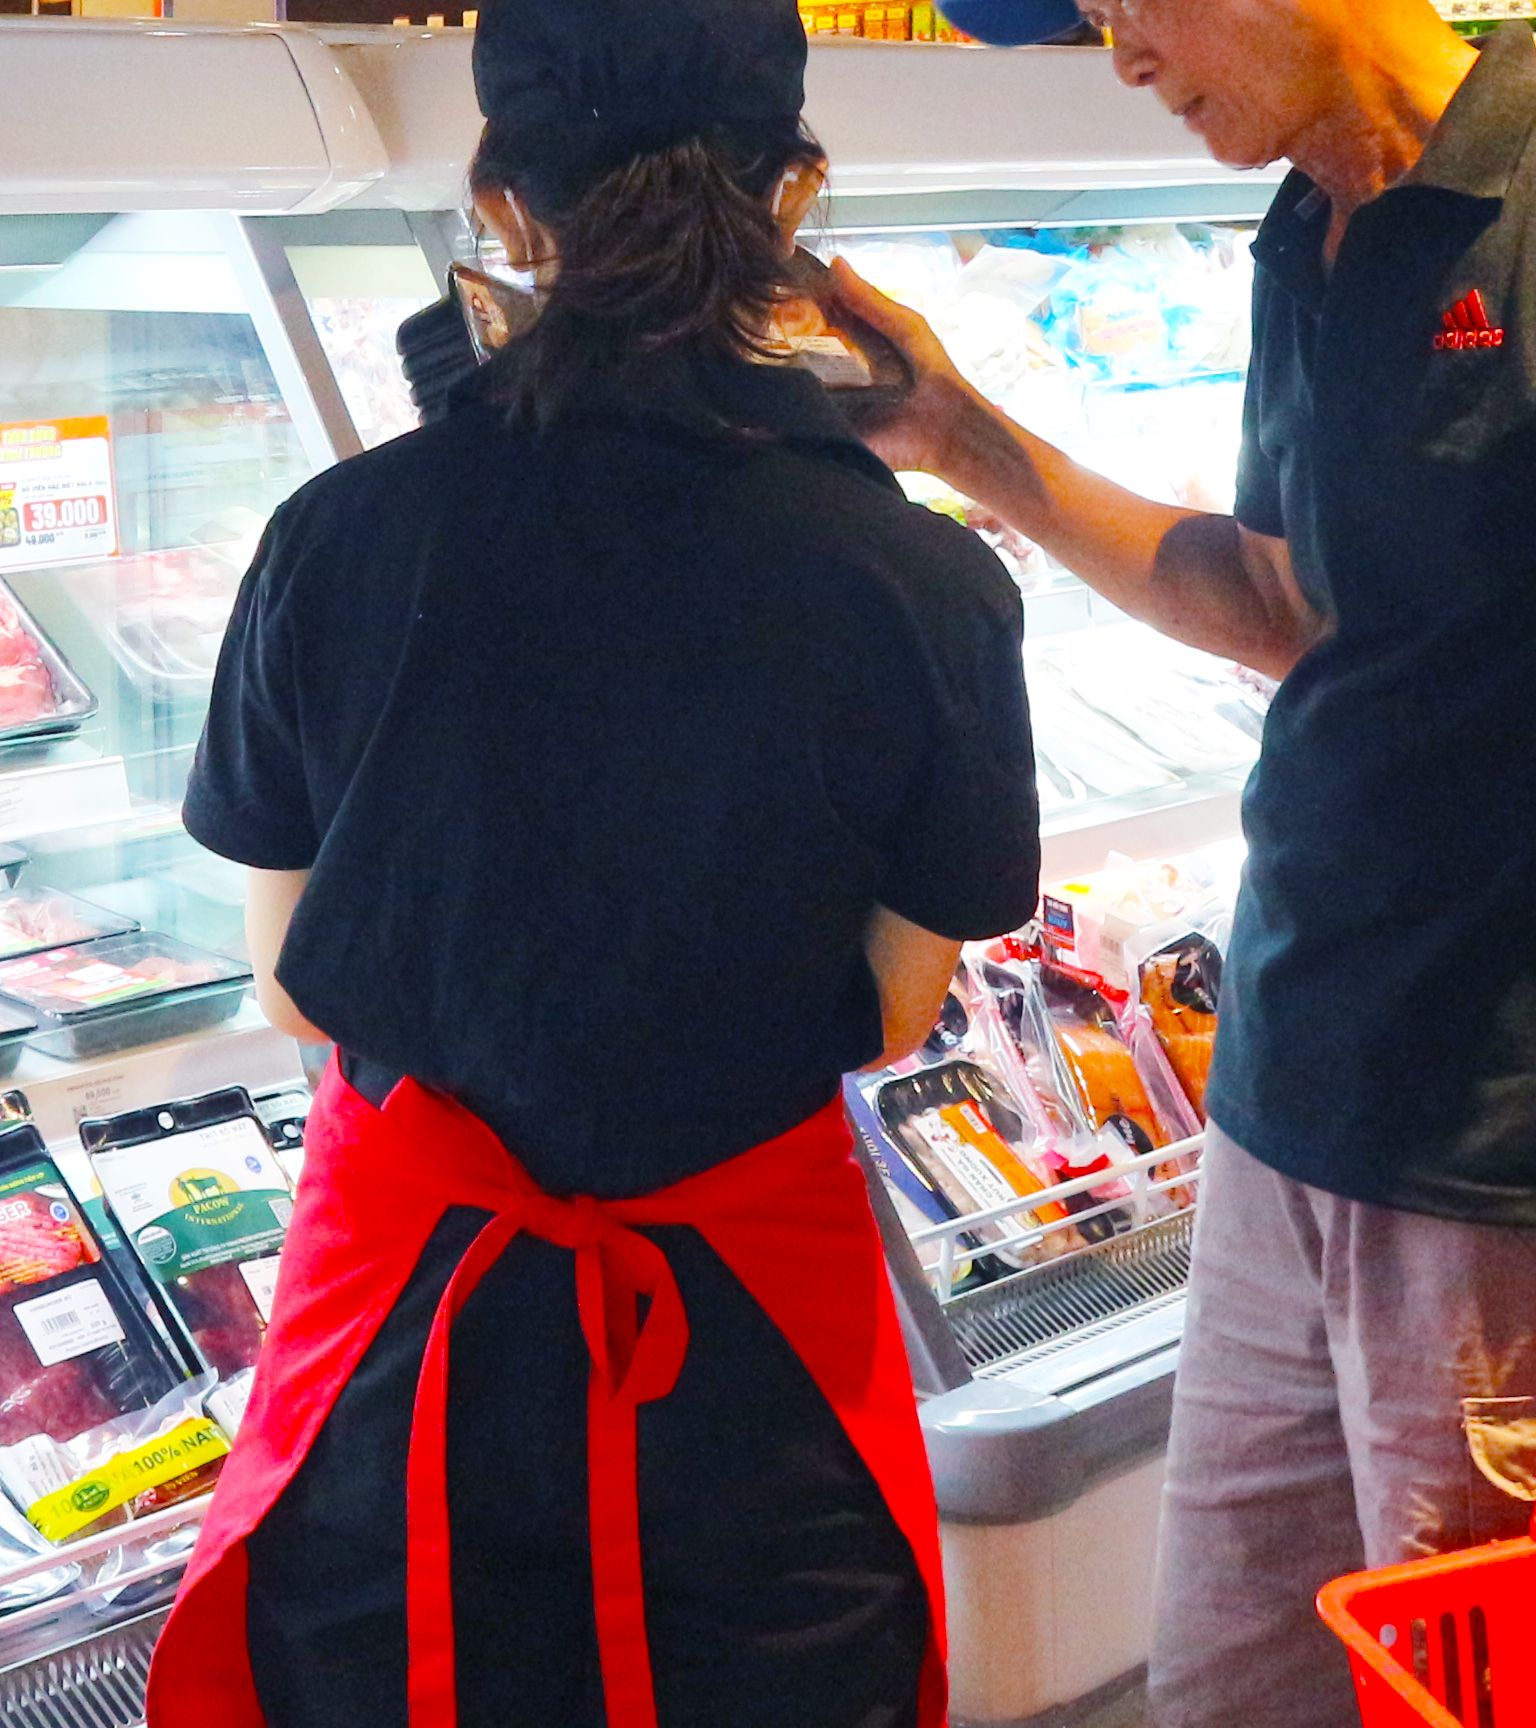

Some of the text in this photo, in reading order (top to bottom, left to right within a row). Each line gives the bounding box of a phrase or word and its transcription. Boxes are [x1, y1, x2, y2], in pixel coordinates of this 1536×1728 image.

[1433, 328, 1505, 350] adidas
[30, 497, 100, 530] 39.000
[192, 1196, 231, 1215] PACOW
[132, 1445, 181, 1473] 100%
